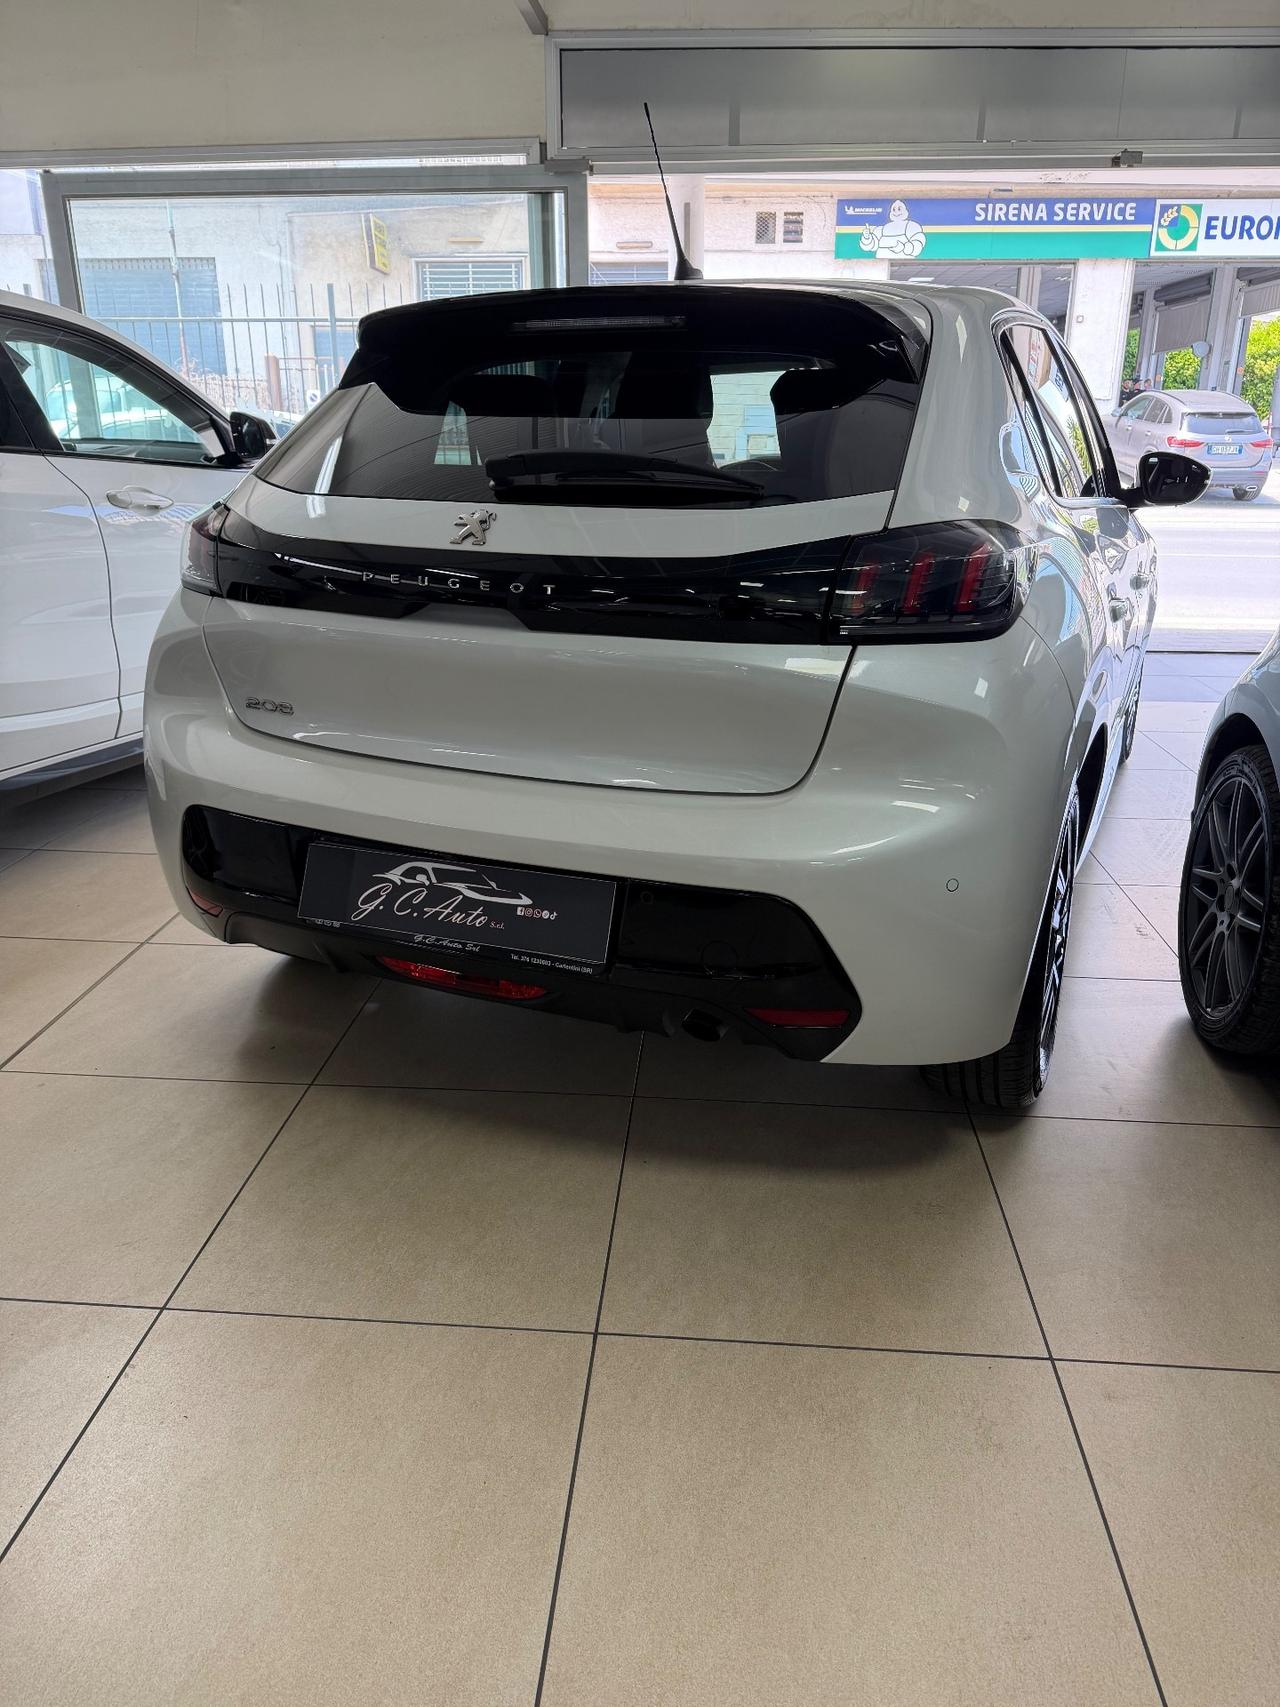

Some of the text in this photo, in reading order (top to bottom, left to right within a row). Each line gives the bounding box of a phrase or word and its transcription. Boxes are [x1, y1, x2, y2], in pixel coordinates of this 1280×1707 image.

[974, 202, 1137, 221] SIRENA SERVICE
[362, 571, 556, 596] PEUGEOT
[423, 895, 489, 928] Auto
